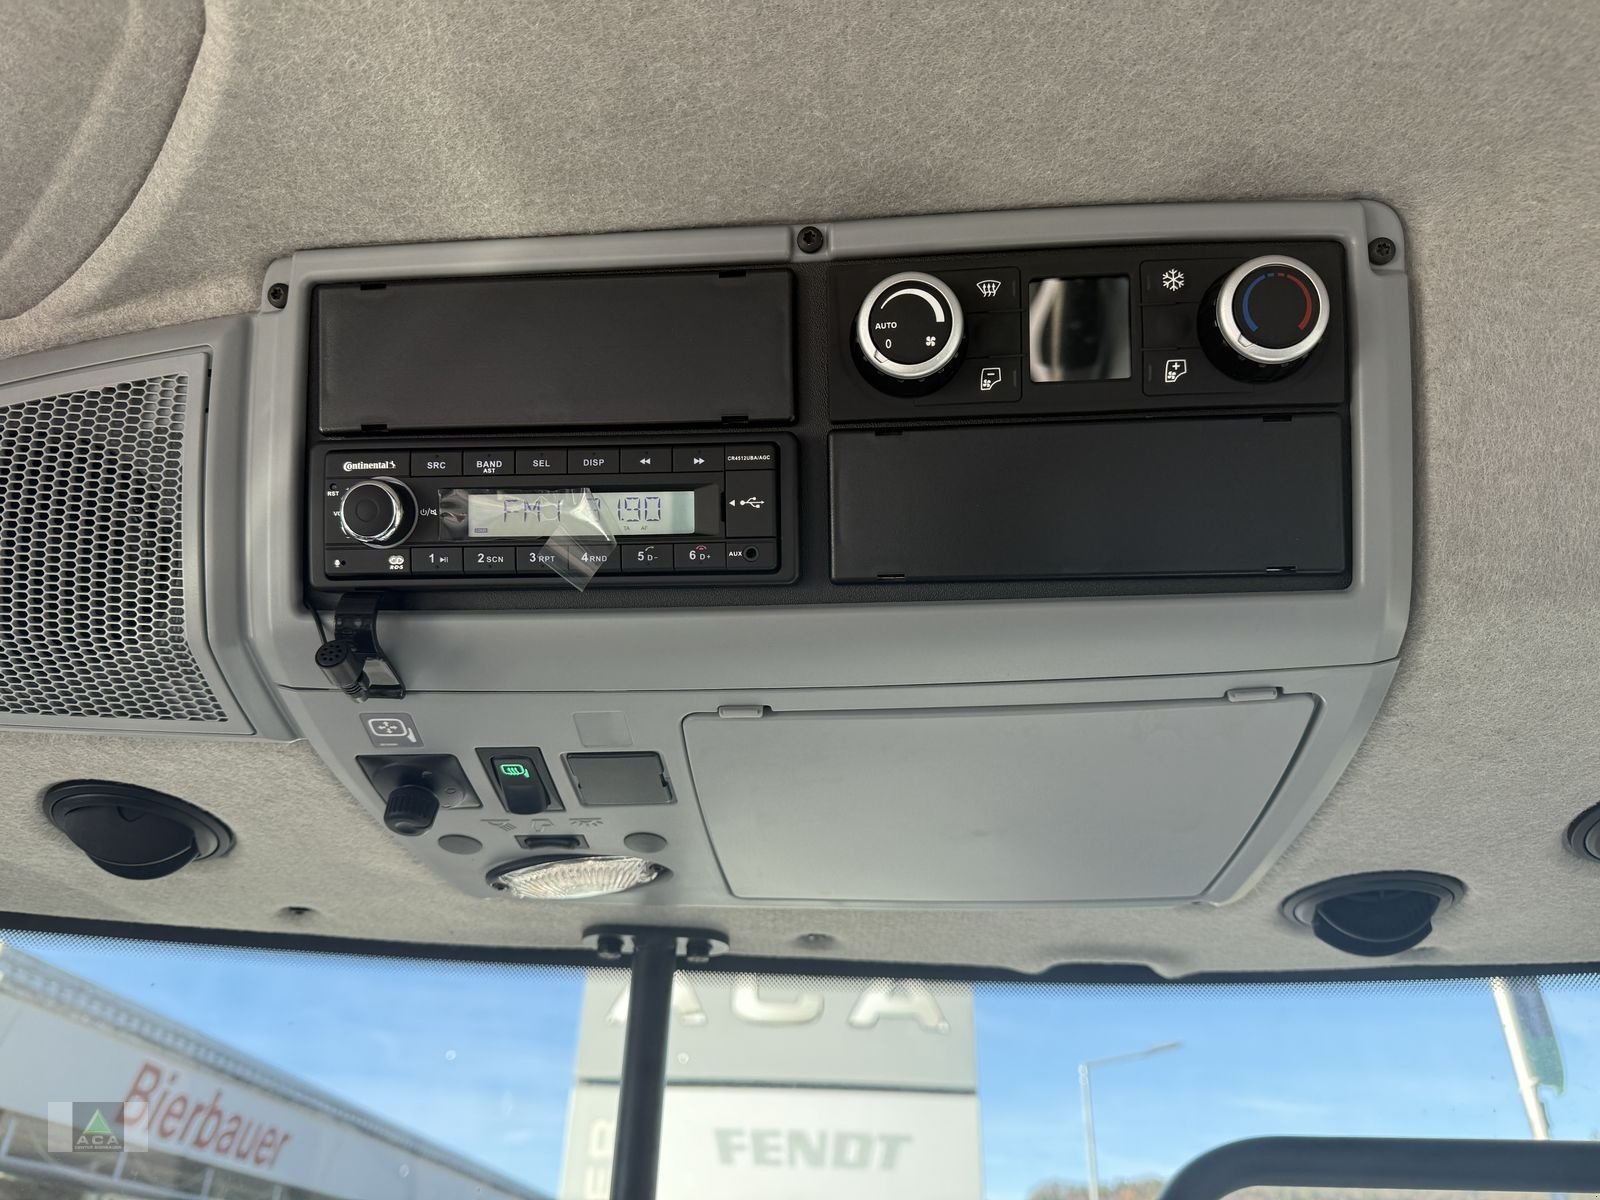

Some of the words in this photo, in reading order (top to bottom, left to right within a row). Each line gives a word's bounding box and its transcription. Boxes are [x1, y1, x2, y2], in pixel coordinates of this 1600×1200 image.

[875, 322, 898, 330] AUTO
[885, 338, 892, 349] 0
[343, 461, 389, 472] Continental
[426, 461, 447, 470] SRC
[476, 460, 503, 468] BAND
[532, 459, 551, 467] SEL
[583, 458, 605, 467] DISP
[428, 554, 435, 563] 1
[477, 553, 485, 564] 2
[486, 556, 504, 564] SCN
[529, 552, 537, 563] 3
[538, 555, 556, 563] RPT
[581, 552, 589, 562] 4
[589, 555, 608, 563] RND
[637, 551, 645, 561] 5
[689, 550, 697, 560] 6
[114, 1062, 293, 1170] Bierbauer
[713, 1125, 912, 1172] FENDT
